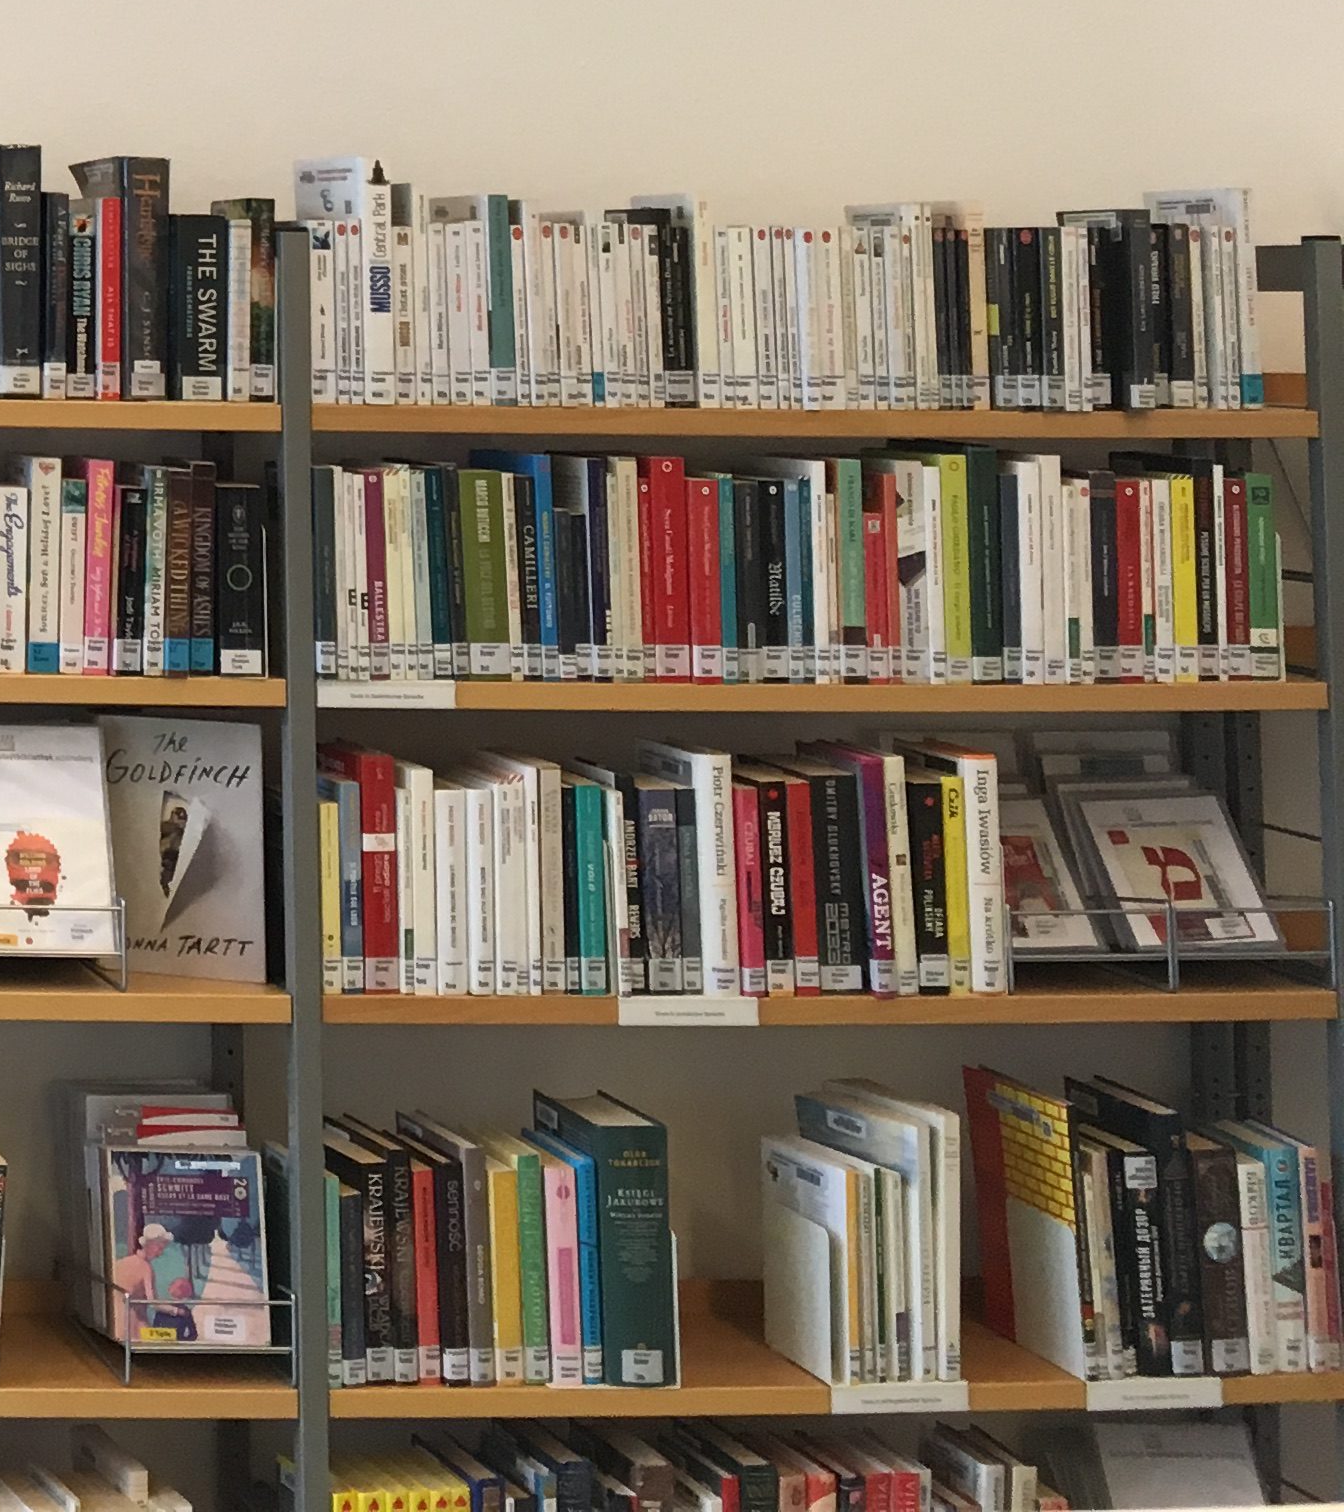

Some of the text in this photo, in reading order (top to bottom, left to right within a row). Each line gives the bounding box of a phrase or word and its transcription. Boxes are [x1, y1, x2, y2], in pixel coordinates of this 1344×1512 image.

[197, 234, 218, 372] THE SWARM
[370, 265, 390, 313] MUSSO
[523, 525, 538, 609] CAMILLERI
[768, 562, 784, 616] Matilde
[374, 581, 384, 641] BALLESTRA
[106, 750, 251, 788] GOLDFINCH
[153, 731, 189, 754] The
[713, 765, 727, 877] Piotr Czerwiński
[977, 769, 993, 874] Inga Iwasiów
[177, 934, 254, 958] TARTT
[872, 872, 892, 951] AGENT
[368, 1173, 383, 1270] KRAJEWSKI
[1274, 1179, 1296, 1260] КВАРТАЛ
